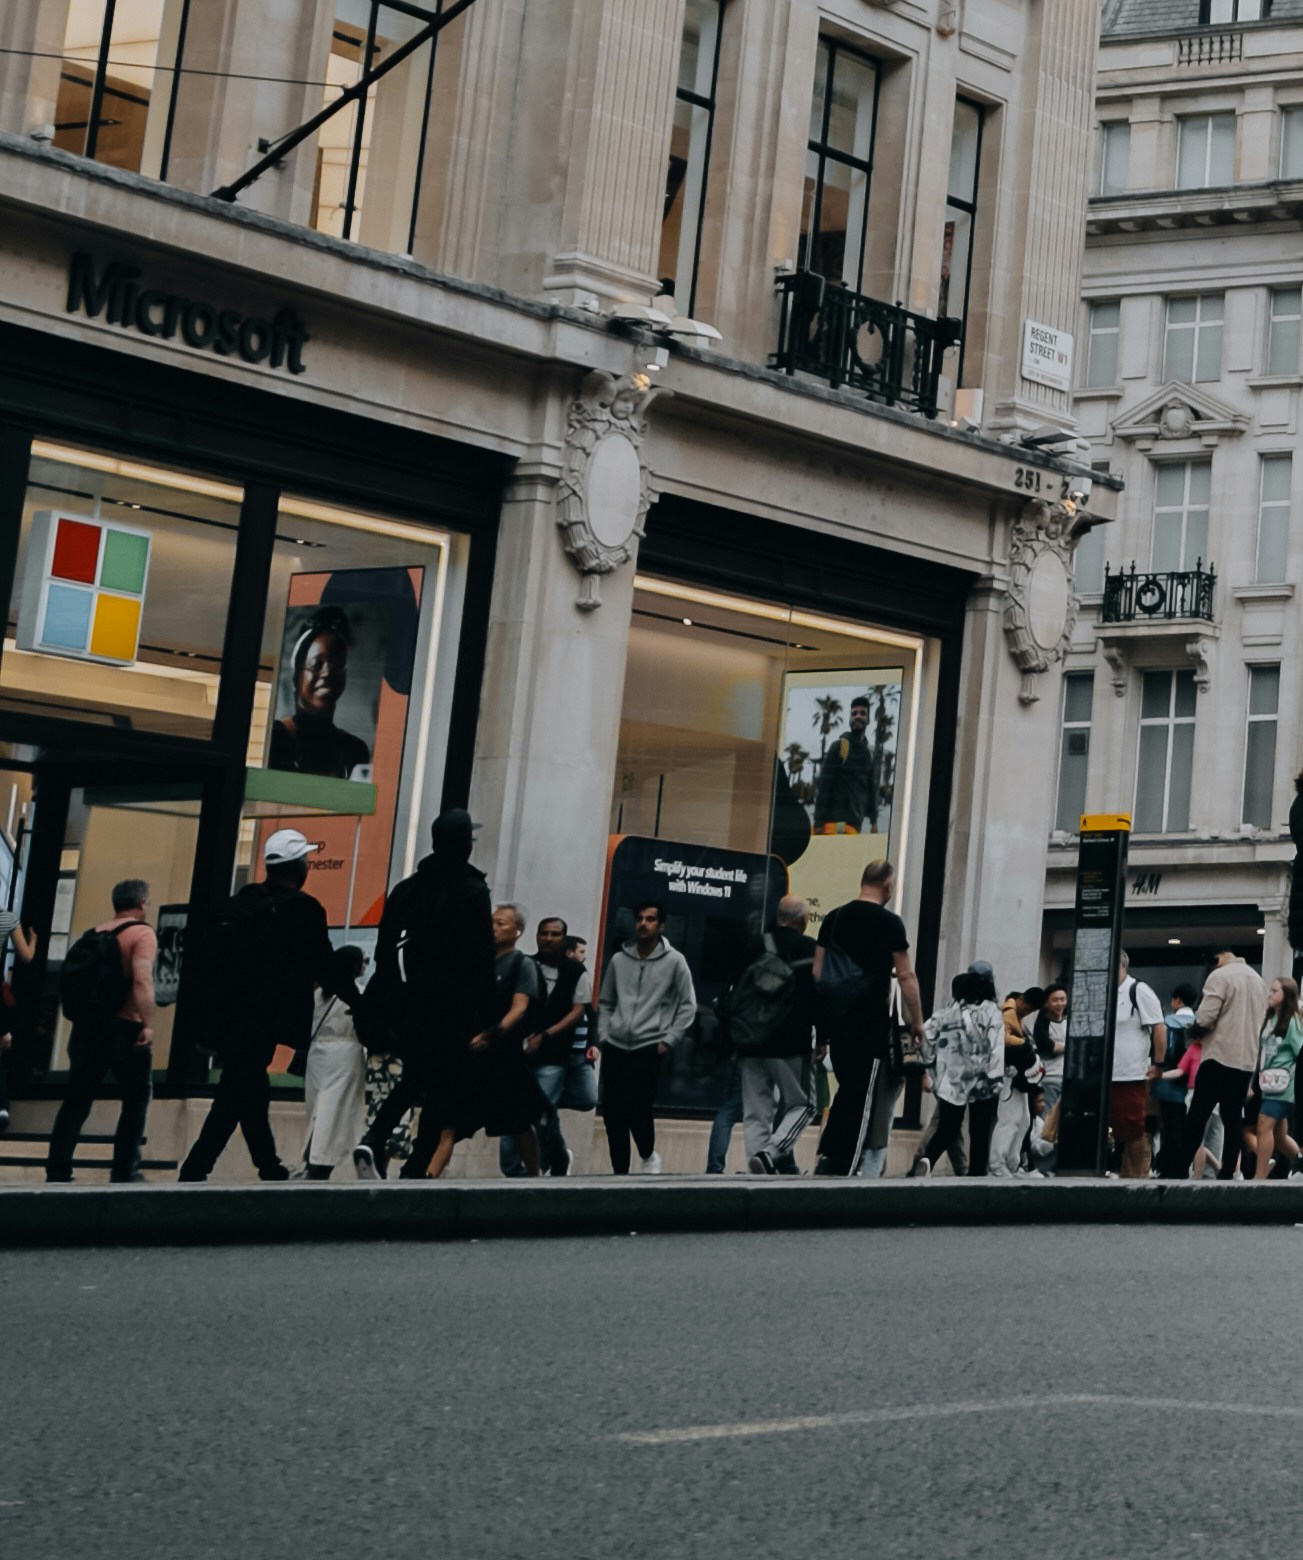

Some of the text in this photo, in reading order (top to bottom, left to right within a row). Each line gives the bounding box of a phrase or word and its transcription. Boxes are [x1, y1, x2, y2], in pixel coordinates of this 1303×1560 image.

[66, 251, 309, 376] Microsoft
[1031, 326, 1057, 346] REGENT
[1030, 342, 1055, 360] STREET
[1057, 351, 1068, 366] W1
[1014, 467, 1041, 493] 251
[654, 859, 748, 883] Simplify your student life
[669, 879, 732, 897] with Windows 11
[1132, 873, 1162, 895] H&M
